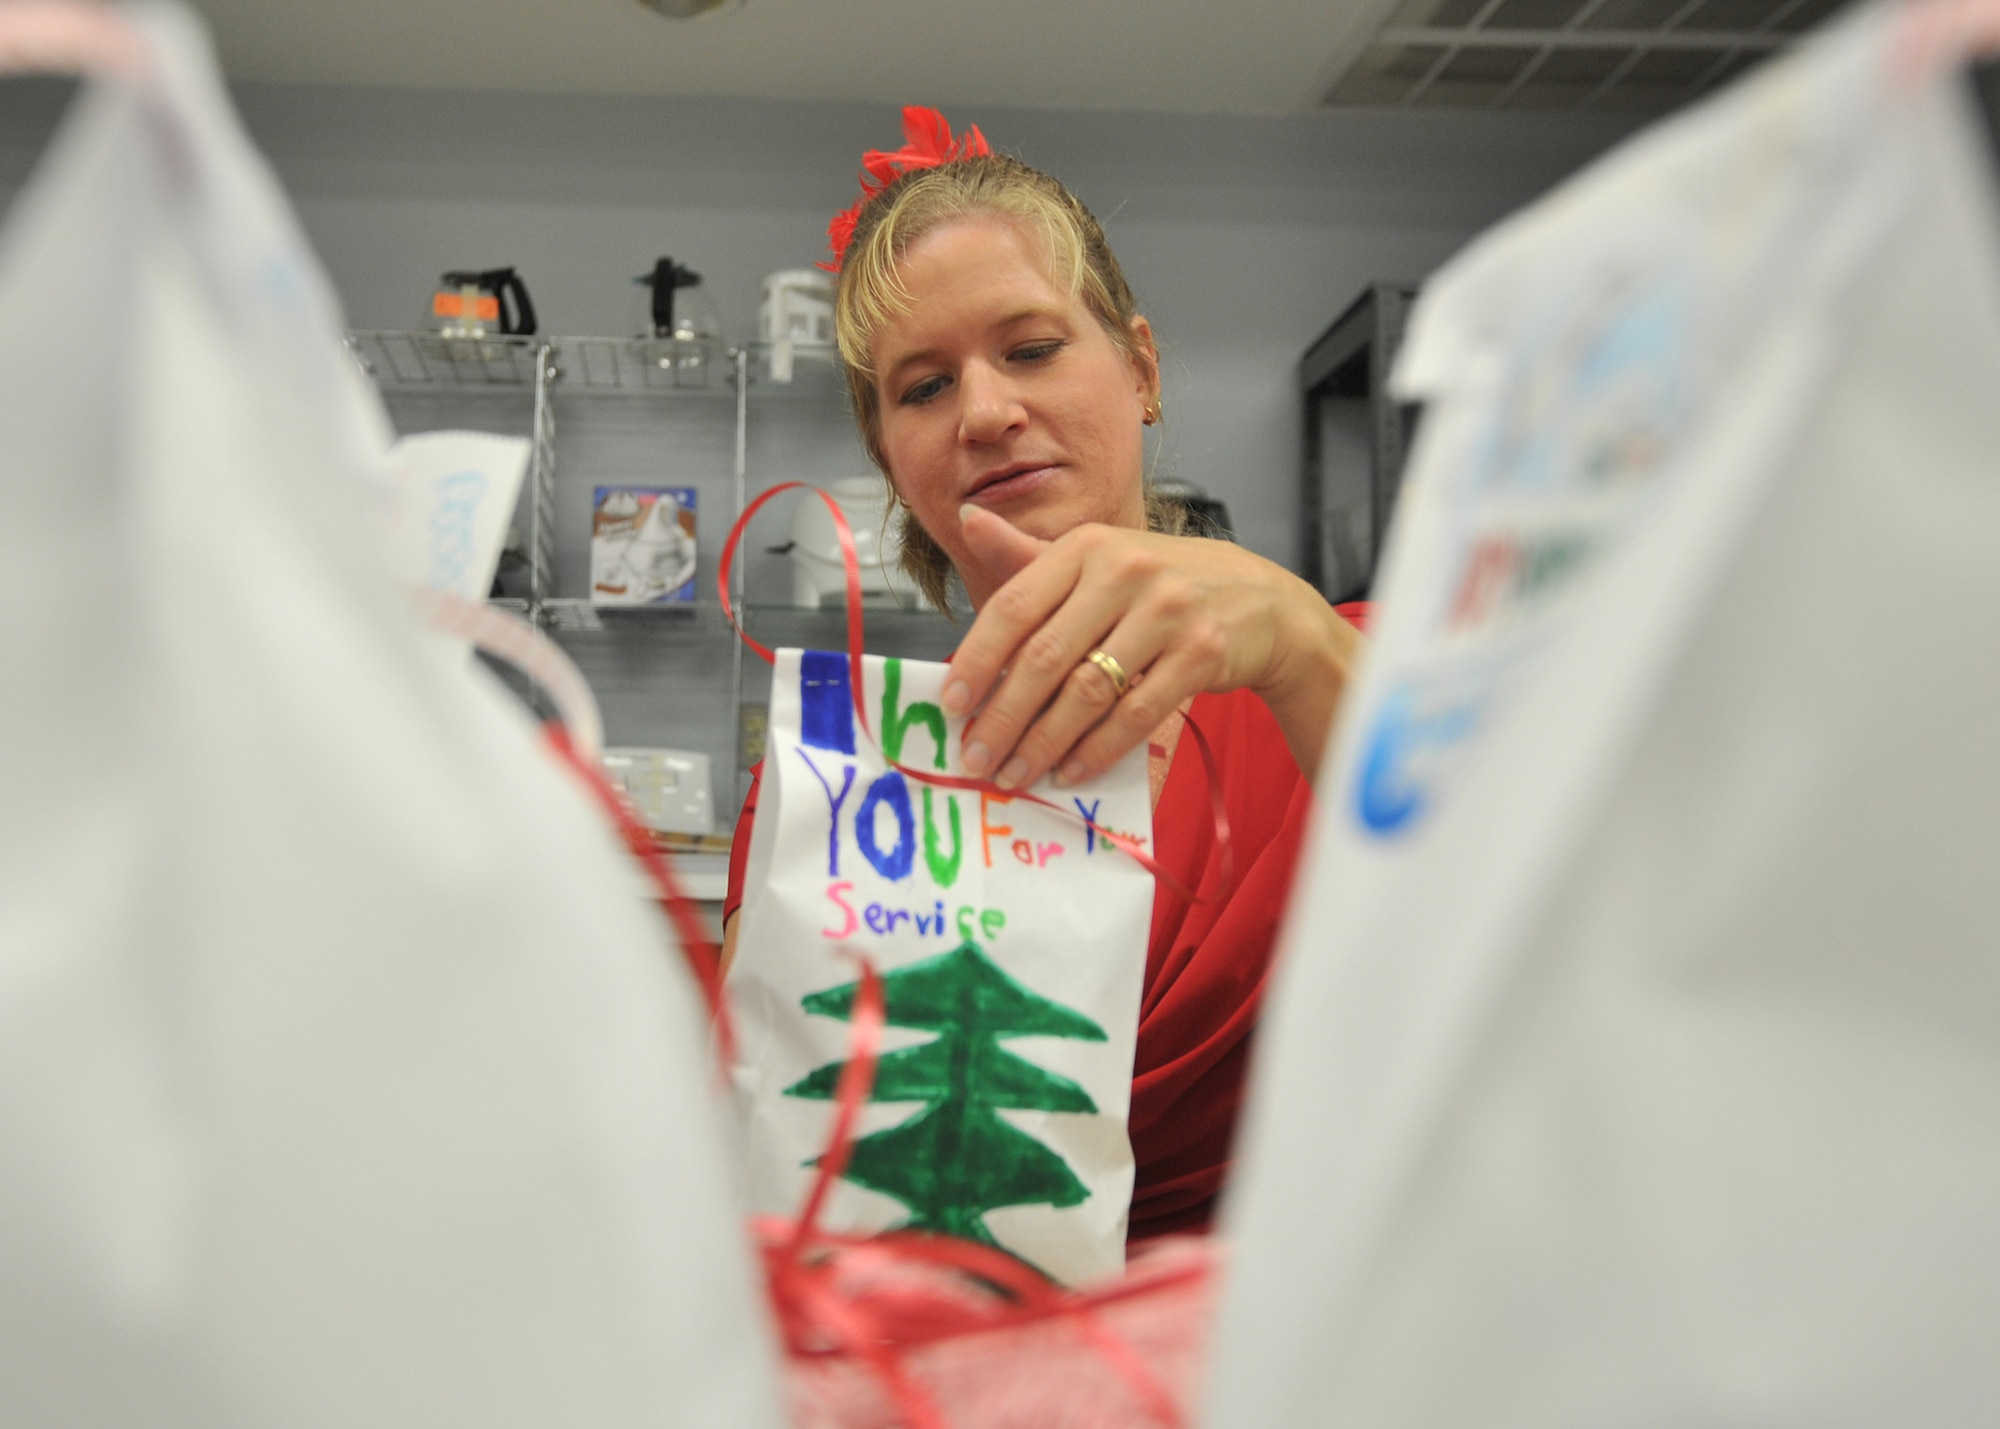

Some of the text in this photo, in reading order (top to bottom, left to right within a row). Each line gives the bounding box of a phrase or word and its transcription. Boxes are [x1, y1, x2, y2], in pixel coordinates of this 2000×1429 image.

[795, 746, 1147, 888] YOU For Yo
[822, 880, 1006, 941] Service
